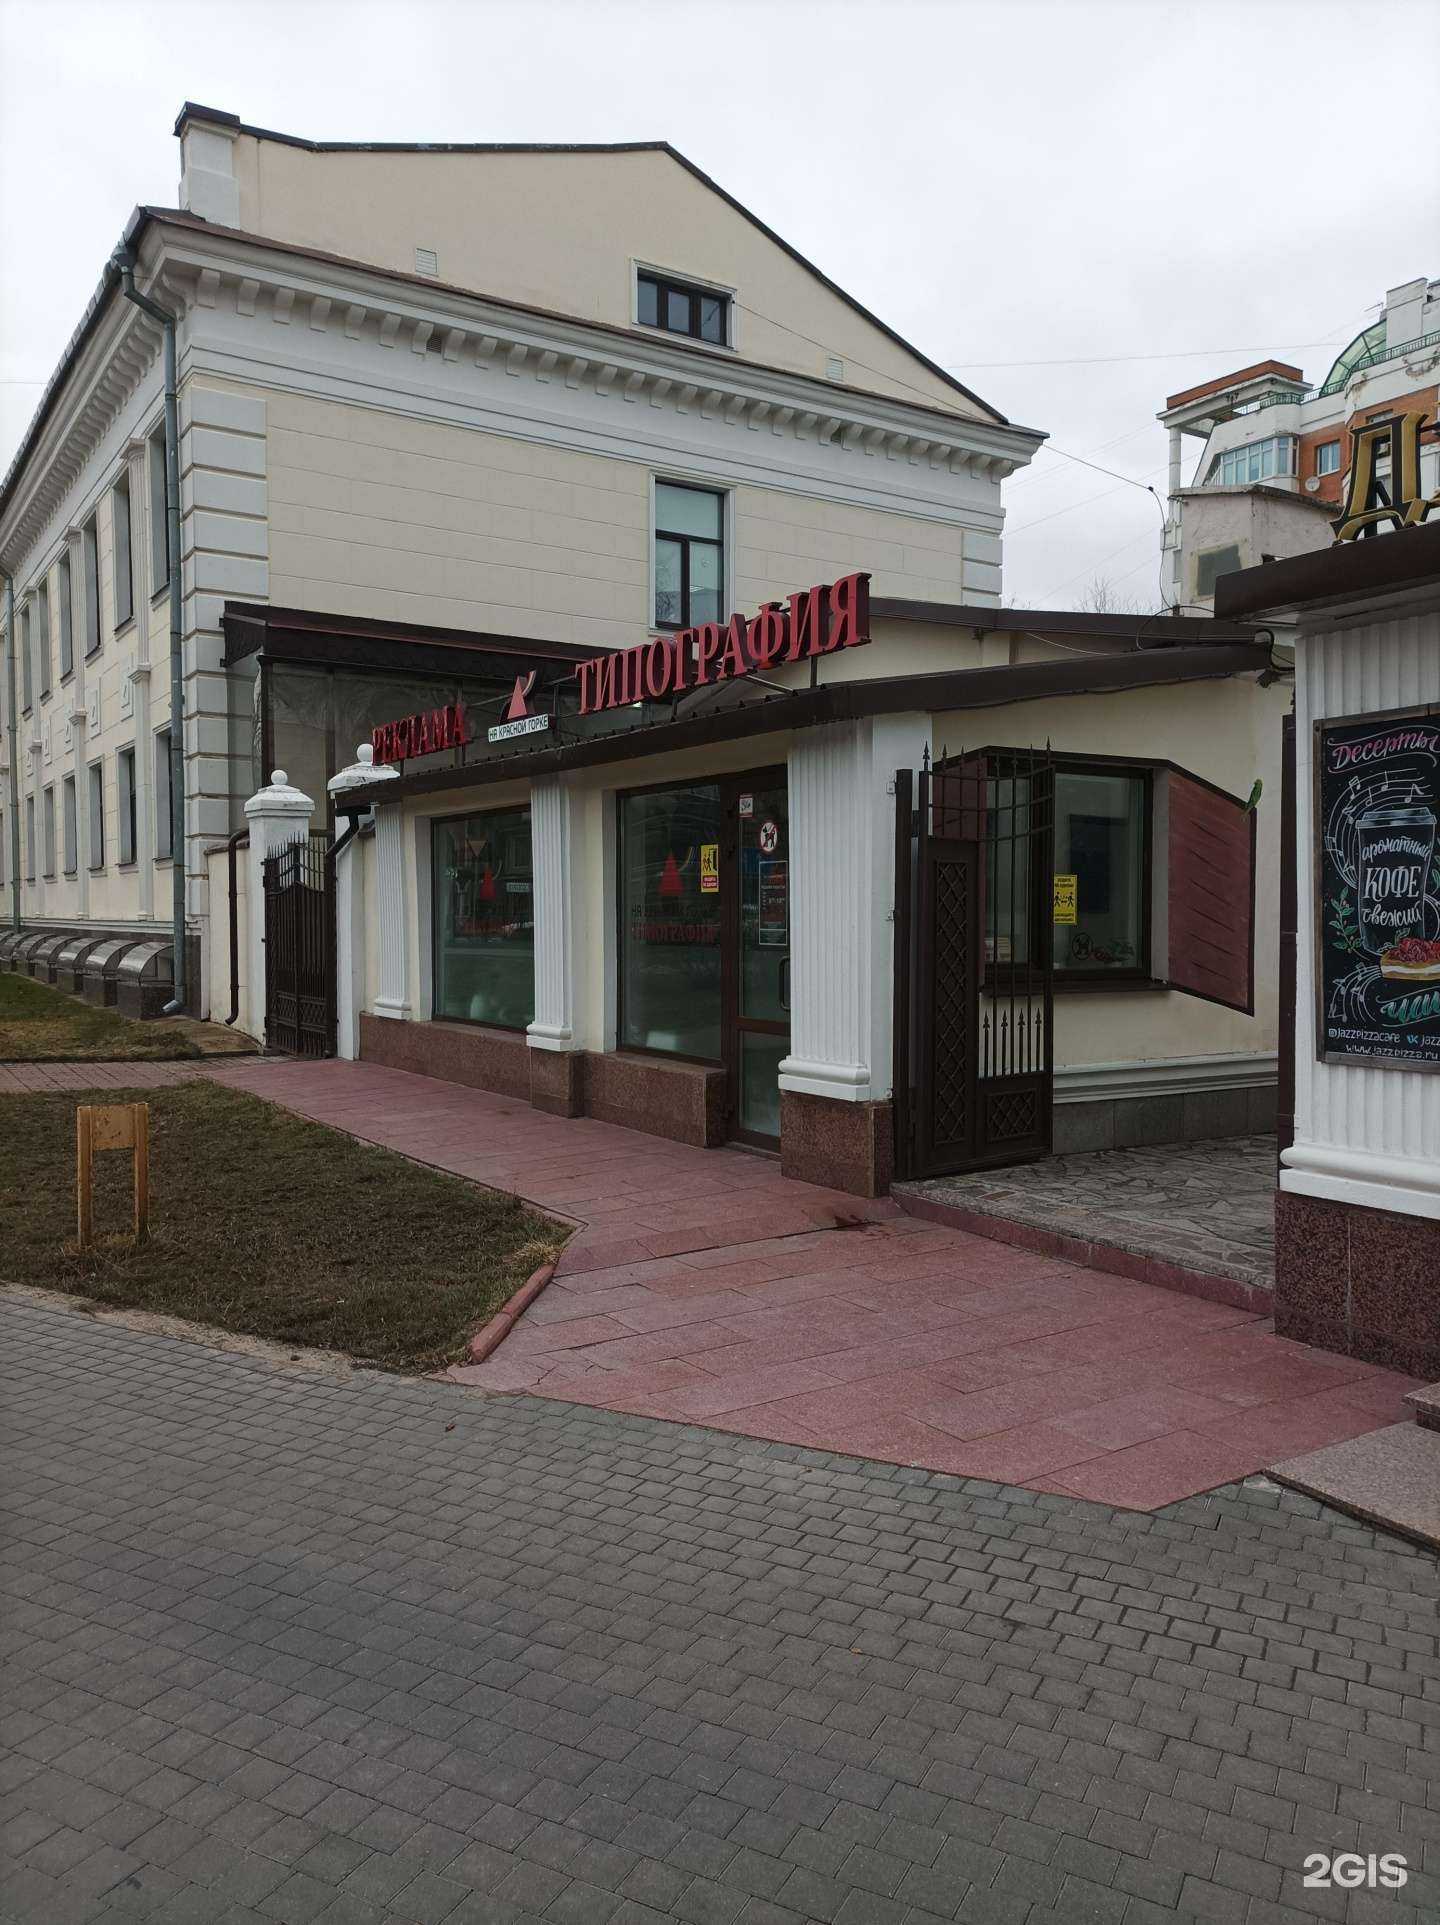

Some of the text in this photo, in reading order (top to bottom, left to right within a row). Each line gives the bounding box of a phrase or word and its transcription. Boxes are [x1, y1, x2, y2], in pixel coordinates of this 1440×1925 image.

[1330, 402, 1440, 546] Д
[575, 572, 872, 716] ТИПОГРАФИЯ
[372, 702, 467, 766] РЕКЛАМА
[489, 715, 548, 741] НА КРАСНОЙ ГОРКЕ
[1332, 731, 1440, 769] Десерты
[1361, 835, 1432, 863] ароматный
[1363, 865, 1422, 901] КОФЕ
[1361, 900, 1424, 928] свежий
[1345, 1044, 1438, 1060] www.jazzpizza.ru
